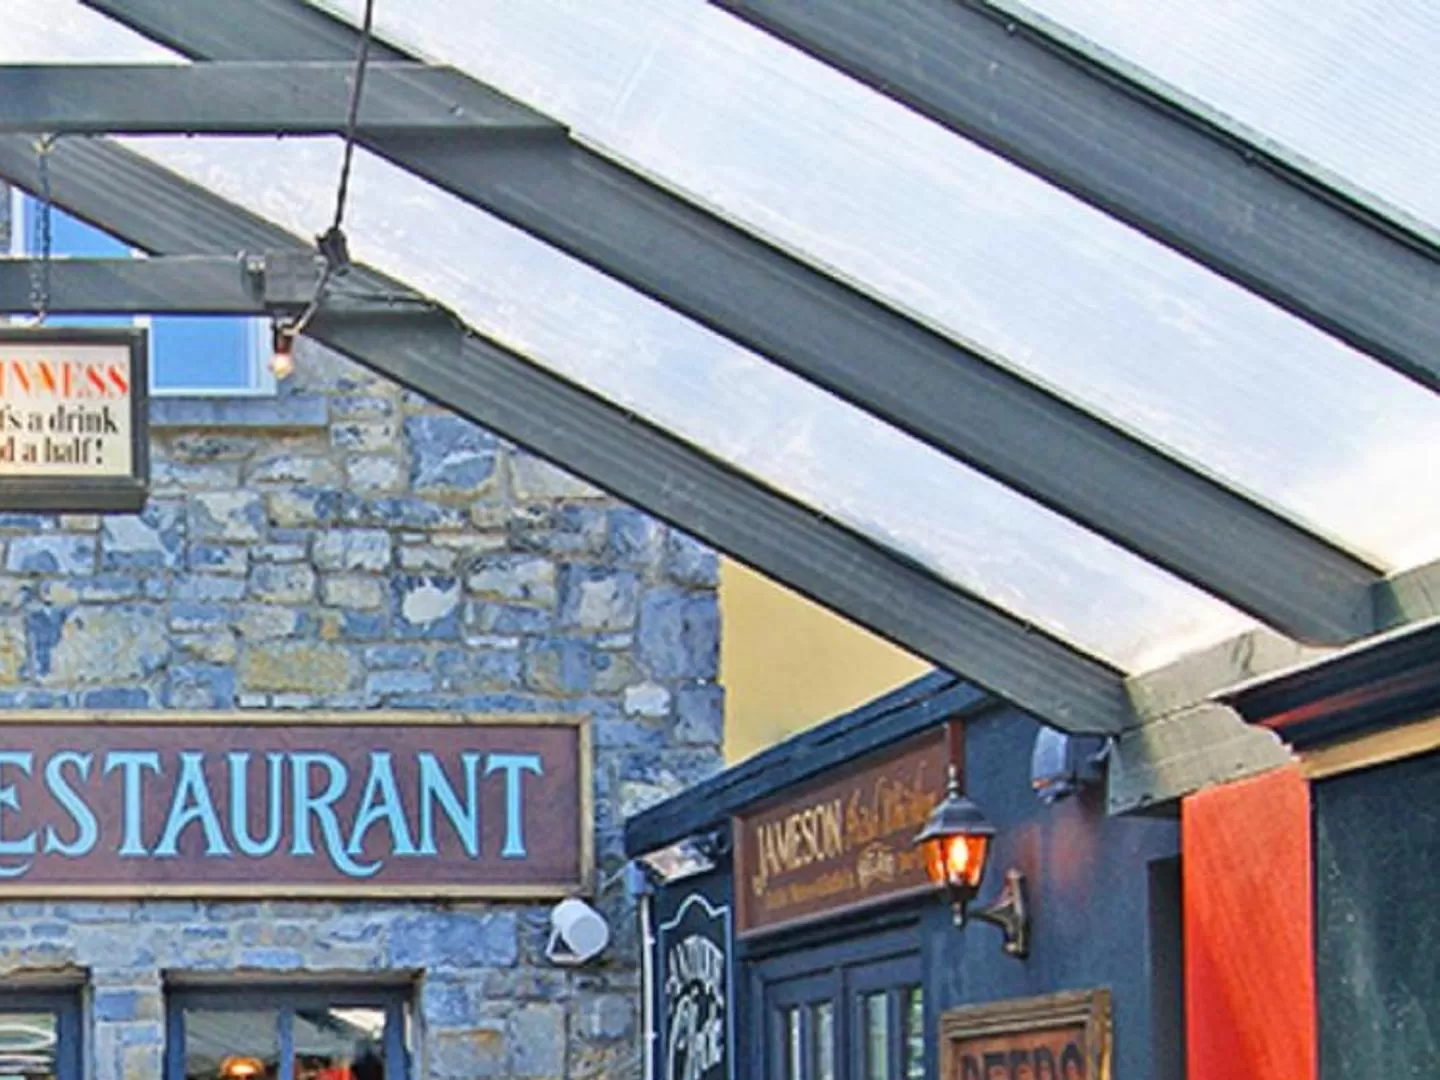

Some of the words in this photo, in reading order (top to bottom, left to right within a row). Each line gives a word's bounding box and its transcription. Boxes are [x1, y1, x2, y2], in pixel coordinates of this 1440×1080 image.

[27, 413, 43, 433] a
[49, 403, 119, 434] drink
[22, 444, 38, 464] a
[45, 437, 103, 466] half!
[753, 799, 844, 896] JAMESON
